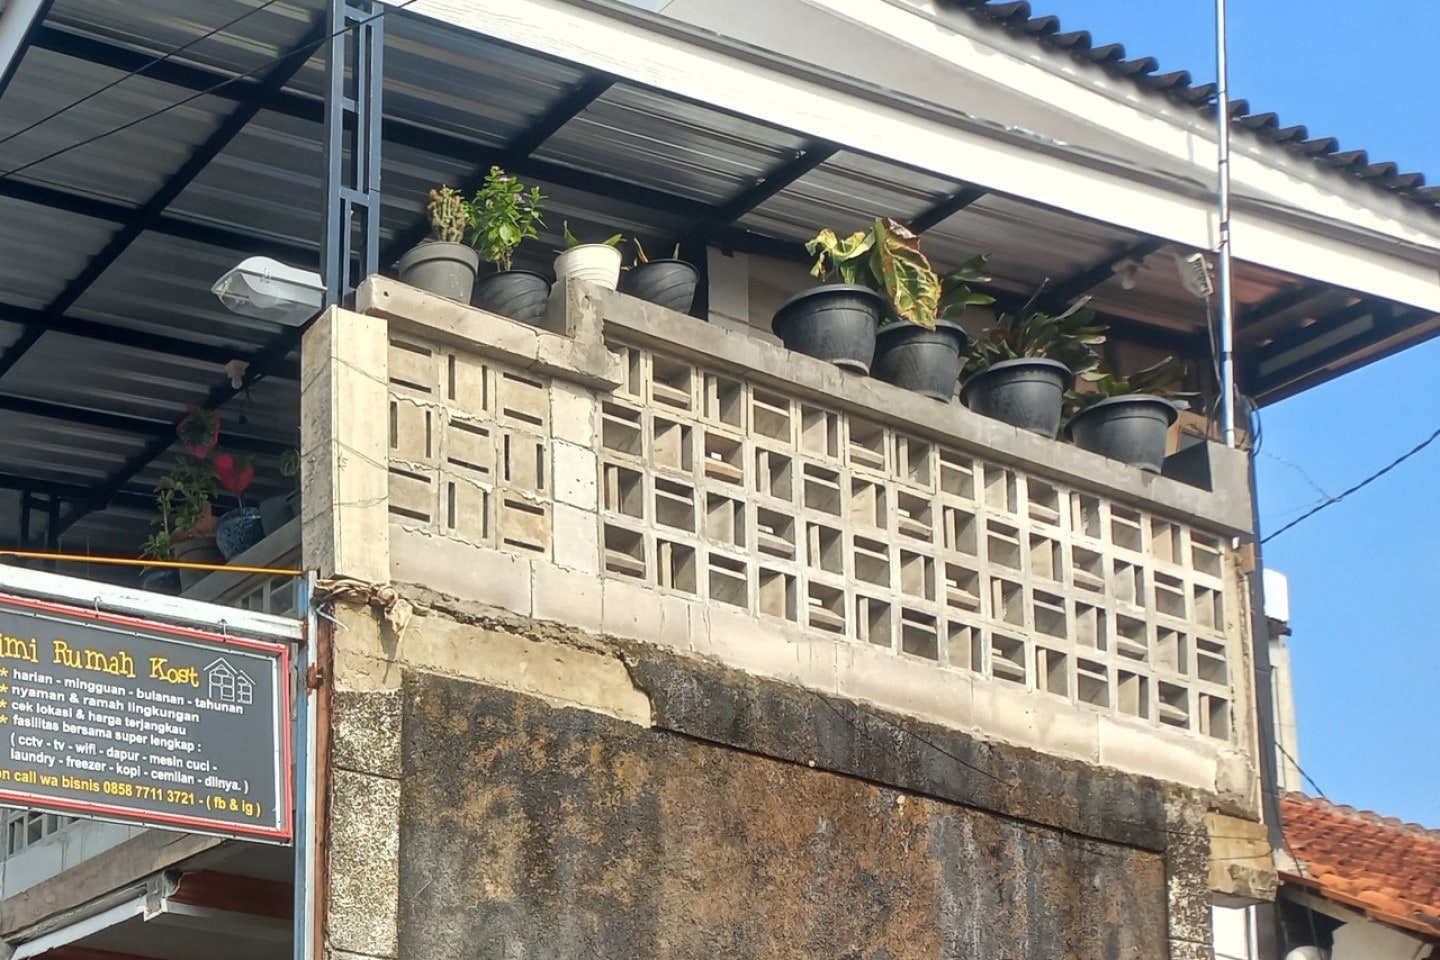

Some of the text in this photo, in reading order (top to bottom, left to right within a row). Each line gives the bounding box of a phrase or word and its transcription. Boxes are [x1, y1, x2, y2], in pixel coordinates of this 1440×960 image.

[53, 640, 136, 678] Rumah
[149, 657, 200, 688] Kost
[12, 686, 199, 722] nyaman & ramah lingkungan
[13, 669, 52, 684] harian
[63, 677, 126, 696] mingguan
[137, 688, 184, 705] bulanan
[195, 698, 243, 714] tahunan
[11, 701, 186, 735] cek lokasi & harga terjangkau
[13, 714, 59, 731] fasilitas
[63, 722, 112, 739] bersama
[115, 730, 148, 744] super
[150, 734, 194, 752] lengkap
[11, 749, 56, 768] laundry
[66, 756, 107, 772] freezer
[116, 763, 141, 779] kopi
[151, 769, 195, 785] cemilan
[18, 736, 44, 747] cctv
[54, 739, 65, 751] tv
[75, 743, 97, 755] wifi
[107, 747, 140, 761] dapur
[150, 754, 183, 768] mesin
[186, 760, 210, 771] cuci
[14, 771, 37, 784] call
[40, 775, 58, 787] wa
[62, 776, 100, 793] bisnis
[103, 781, 133, 797] 0858
[135, 785, 162, 801] 7711
[167, 791, 195, 805] 3721
[214, 796, 226, 809] fb
[229, 799, 238, 811] &
[242, 800, 253, 816] ig
